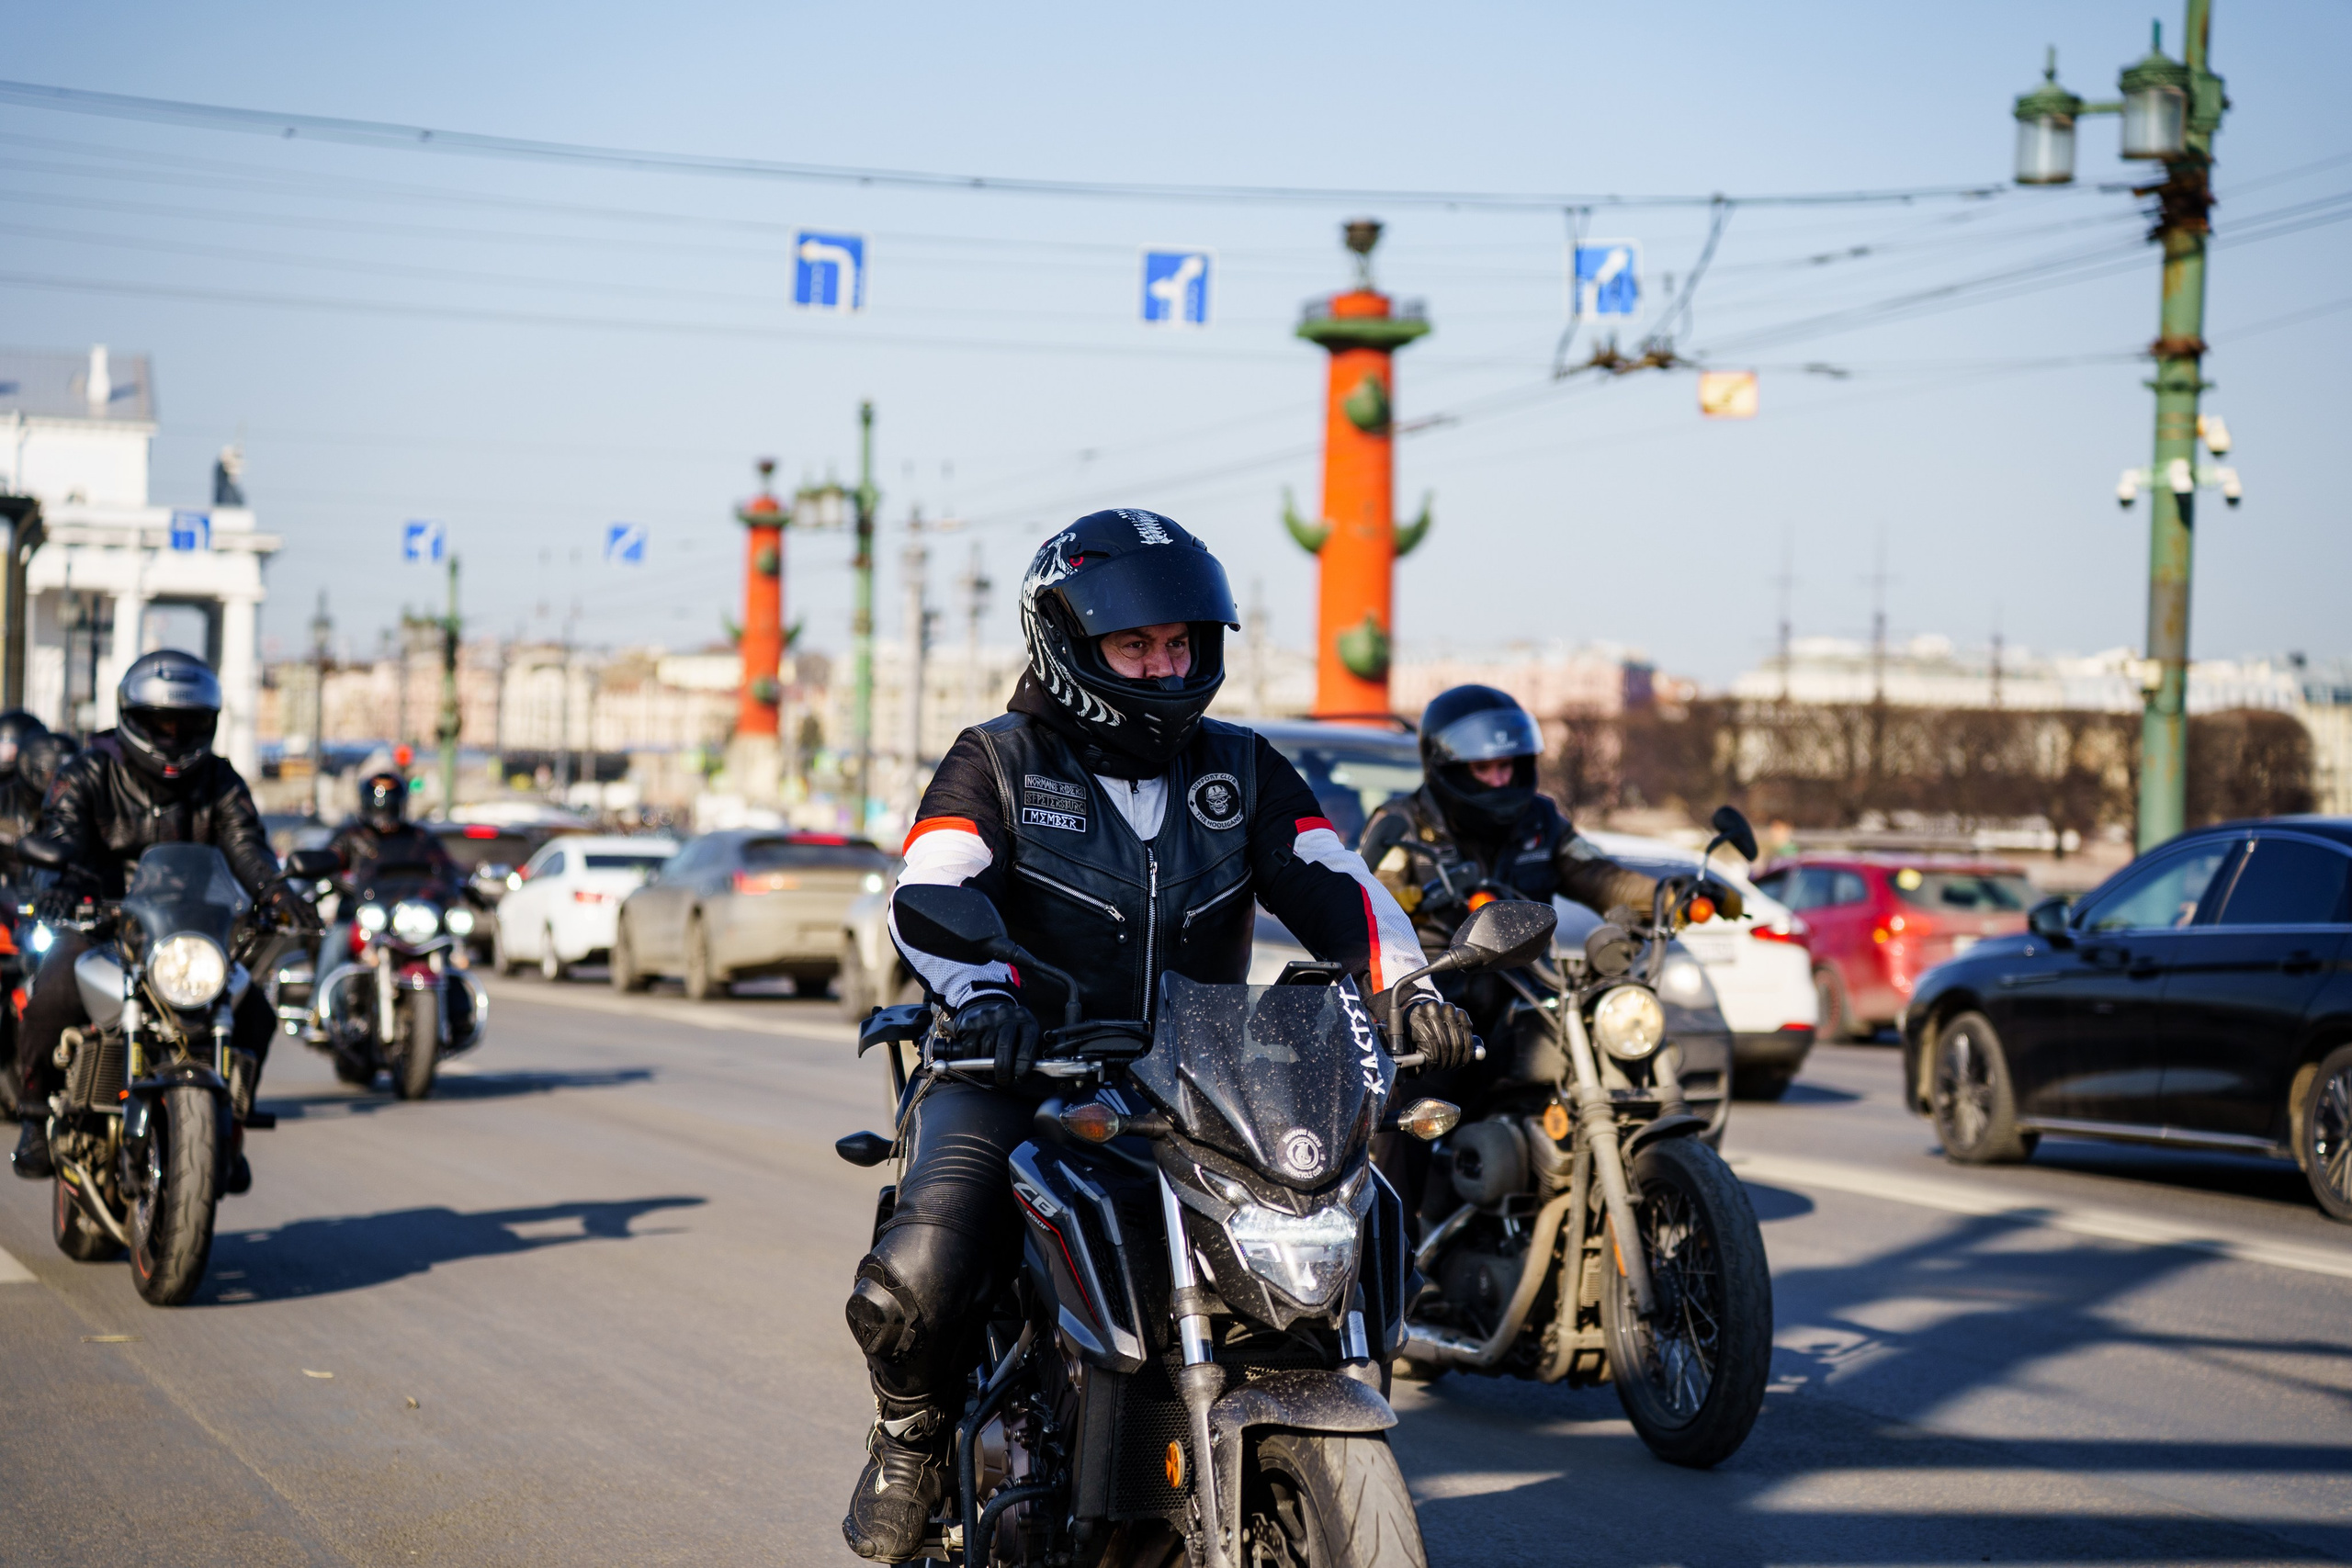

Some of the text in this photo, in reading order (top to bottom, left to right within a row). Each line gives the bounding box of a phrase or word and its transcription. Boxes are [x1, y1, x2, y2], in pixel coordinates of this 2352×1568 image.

[1027, 777, 1084, 796] NORMANS RIDERS
[1192, 774, 1237, 791] SUPPORT CLUB
[1030, 811, 1076, 829] MEMBER
[1196, 812, 1207, 823] THE
[1013, 1181, 1058, 1218] CB
